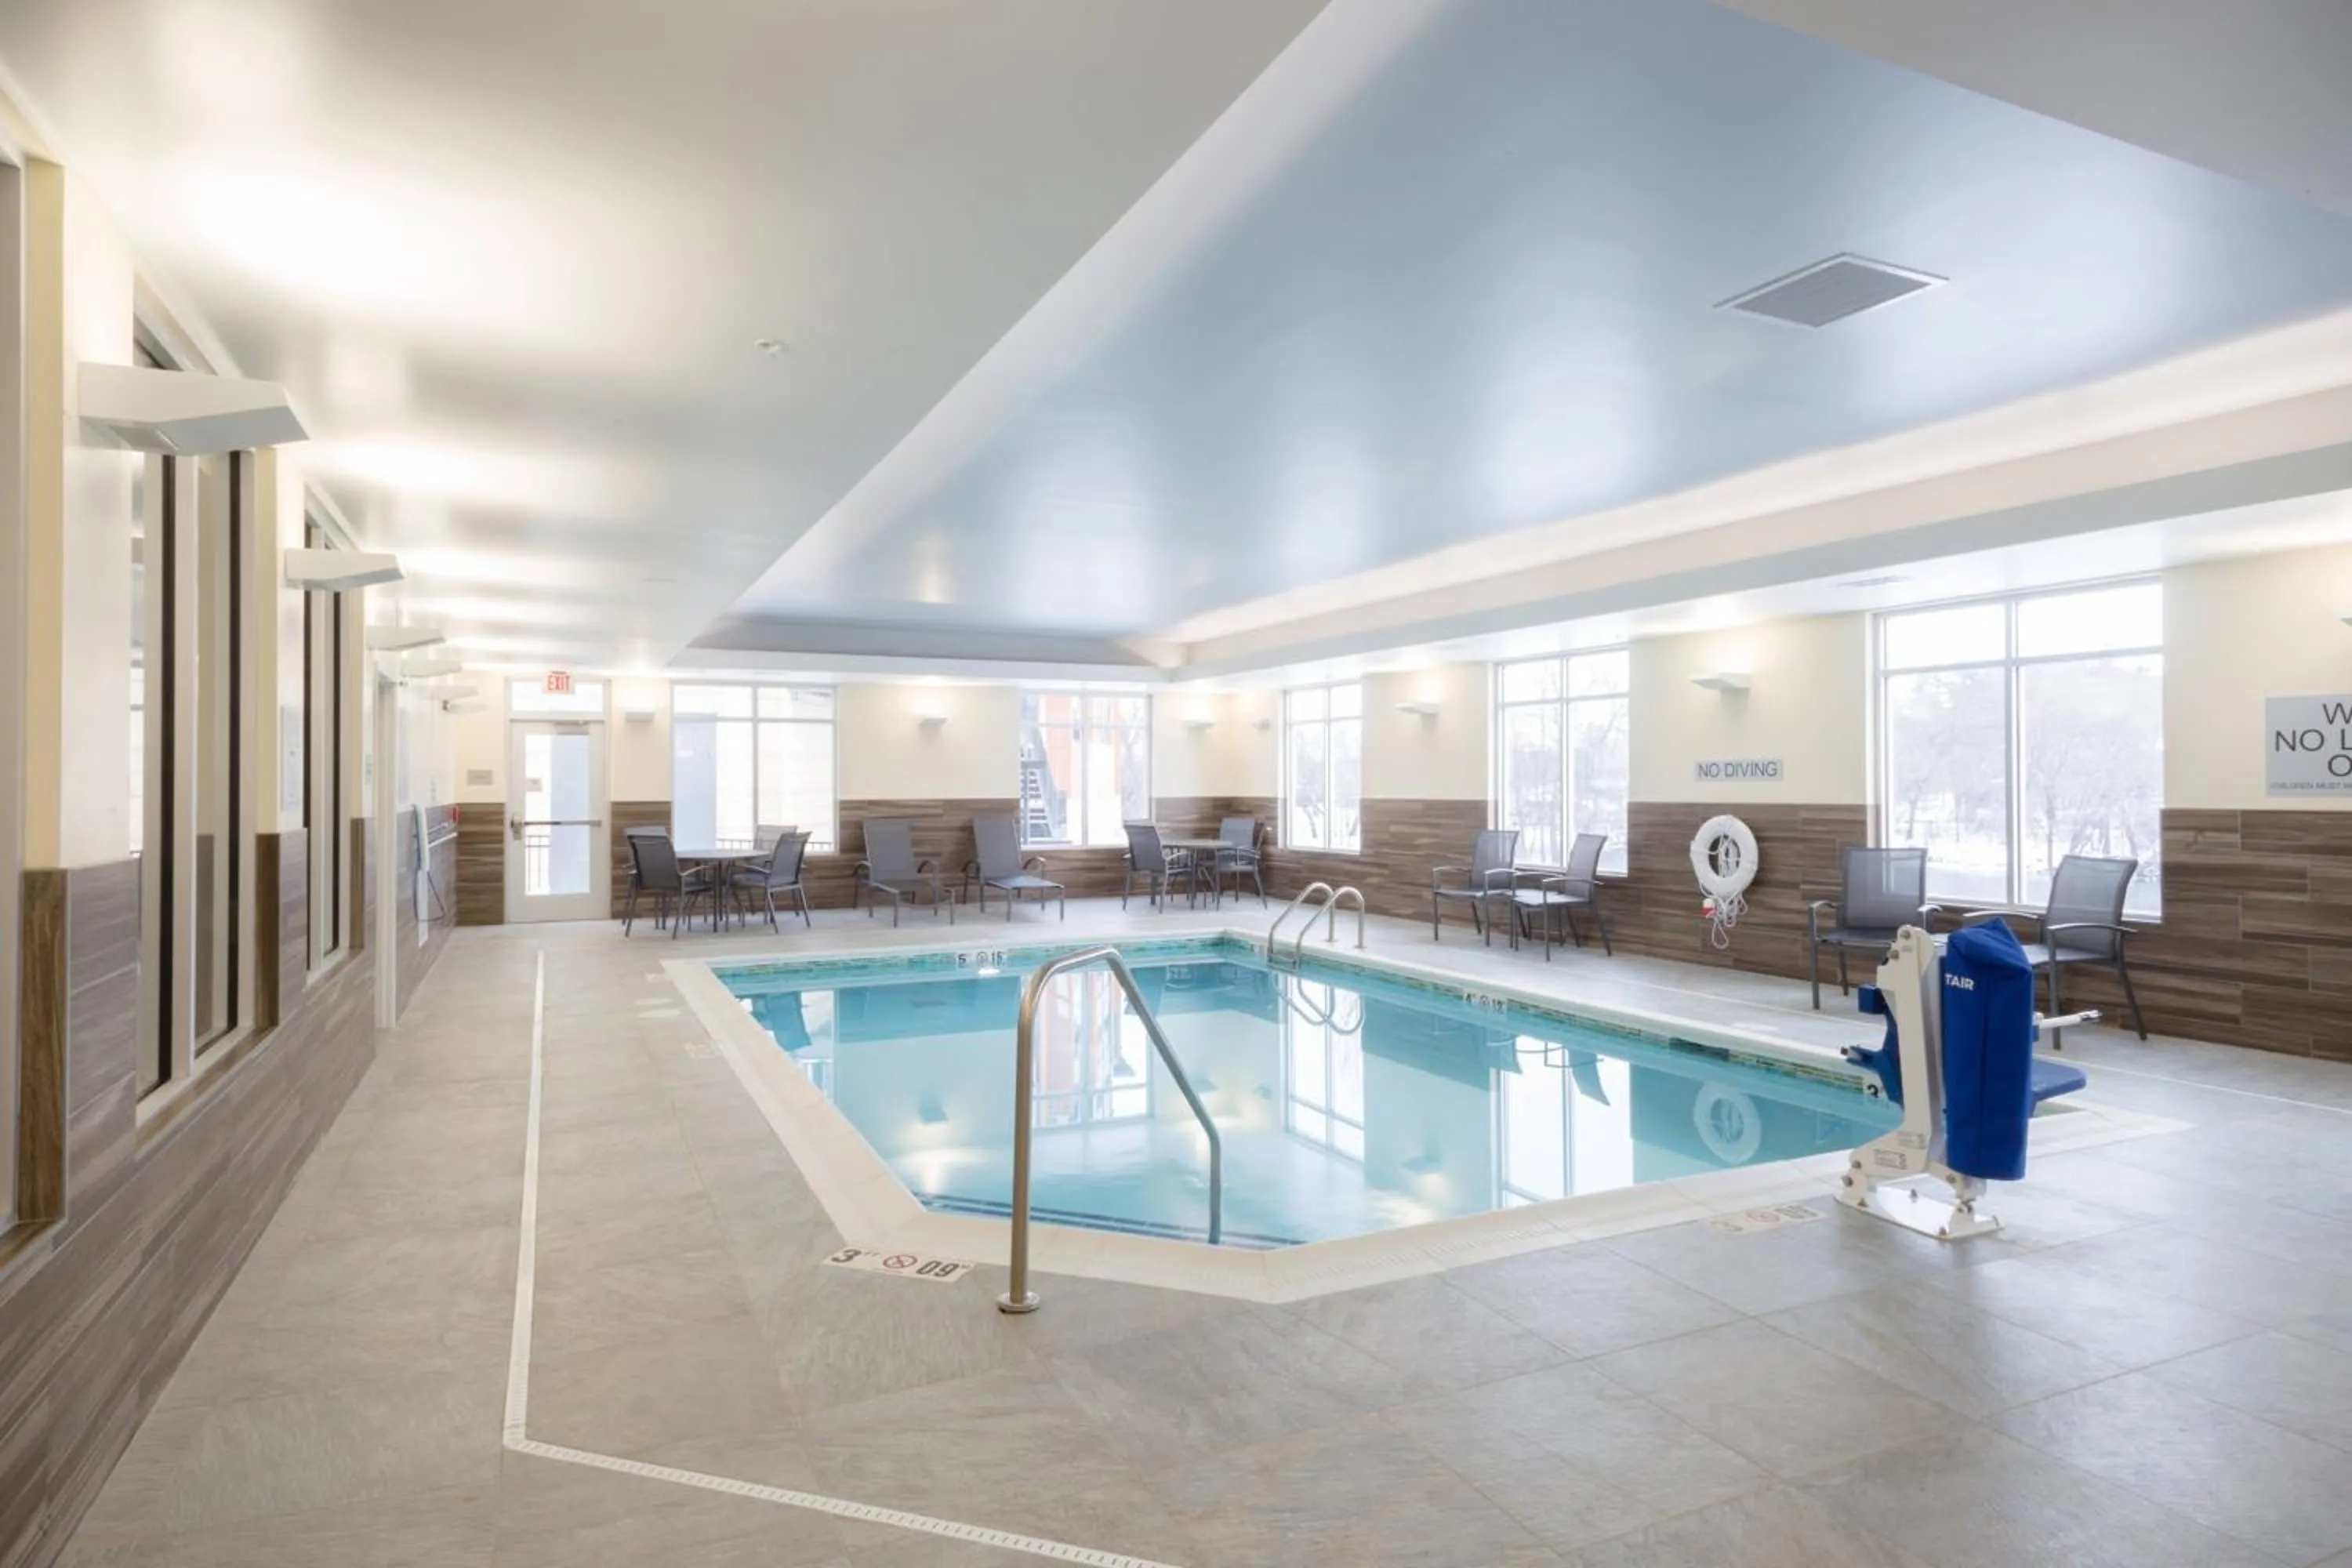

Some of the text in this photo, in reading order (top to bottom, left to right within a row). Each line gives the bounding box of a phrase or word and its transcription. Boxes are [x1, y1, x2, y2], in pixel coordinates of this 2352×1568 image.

[548, 675, 571, 691] EXIT
[2275, 728, 2325, 753] NO
[1698, 761, 1777, 779] NO DIVING
[1944, 973, 1975, 991] TAIR
[831, 1249, 862, 1263] 3
[916, 1260, 960, 1277] 09
